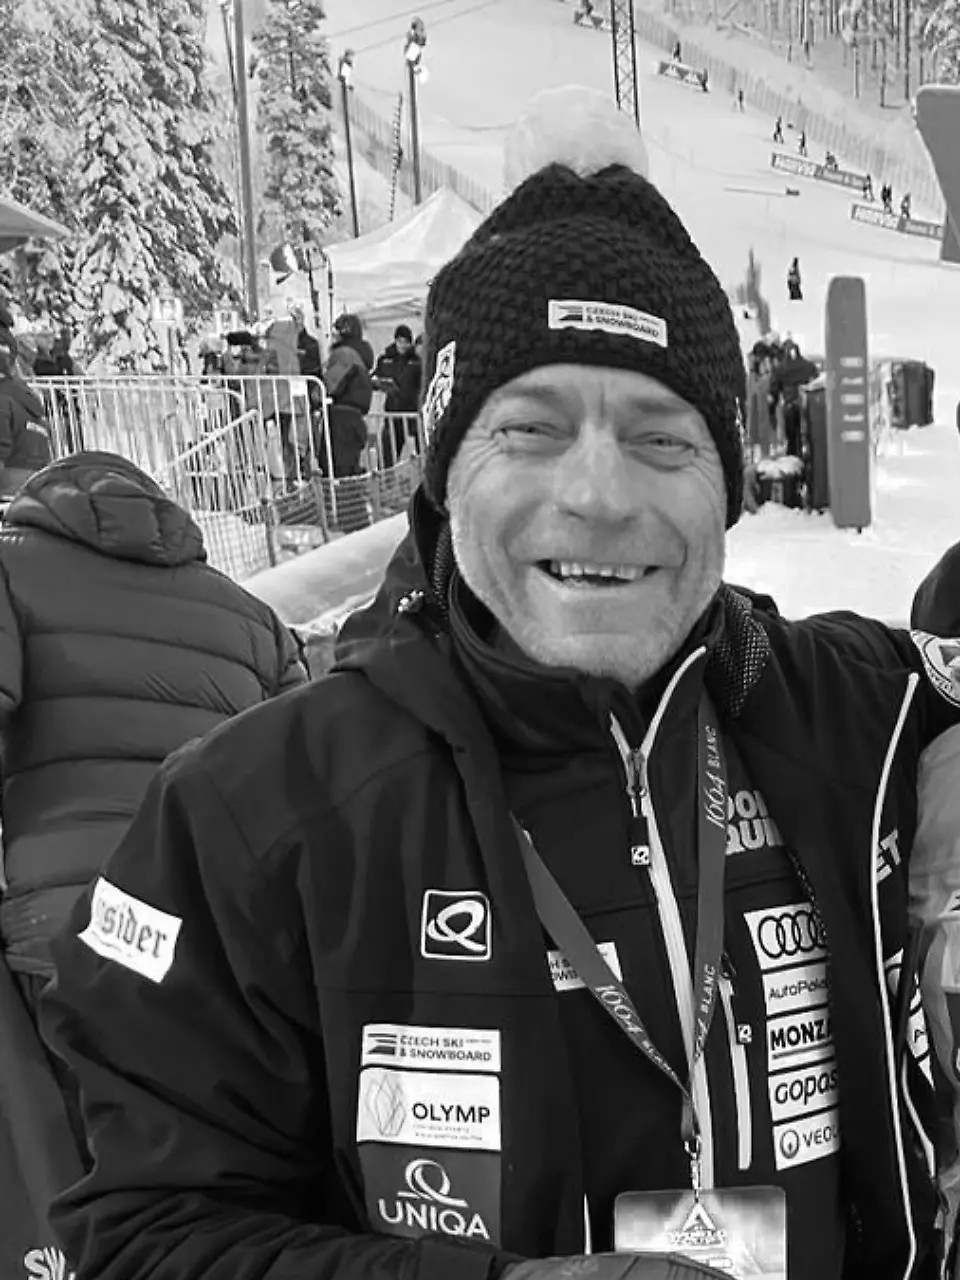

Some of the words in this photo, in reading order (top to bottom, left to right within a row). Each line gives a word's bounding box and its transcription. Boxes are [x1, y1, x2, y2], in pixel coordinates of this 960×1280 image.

[101, 902, 167, 958] sider
[409, 1048, 493, 1062] SNOWBOARD
[411, 1102, 491, 1123] OLYMP
[377, 1197, 490, 1240] UNIQA
